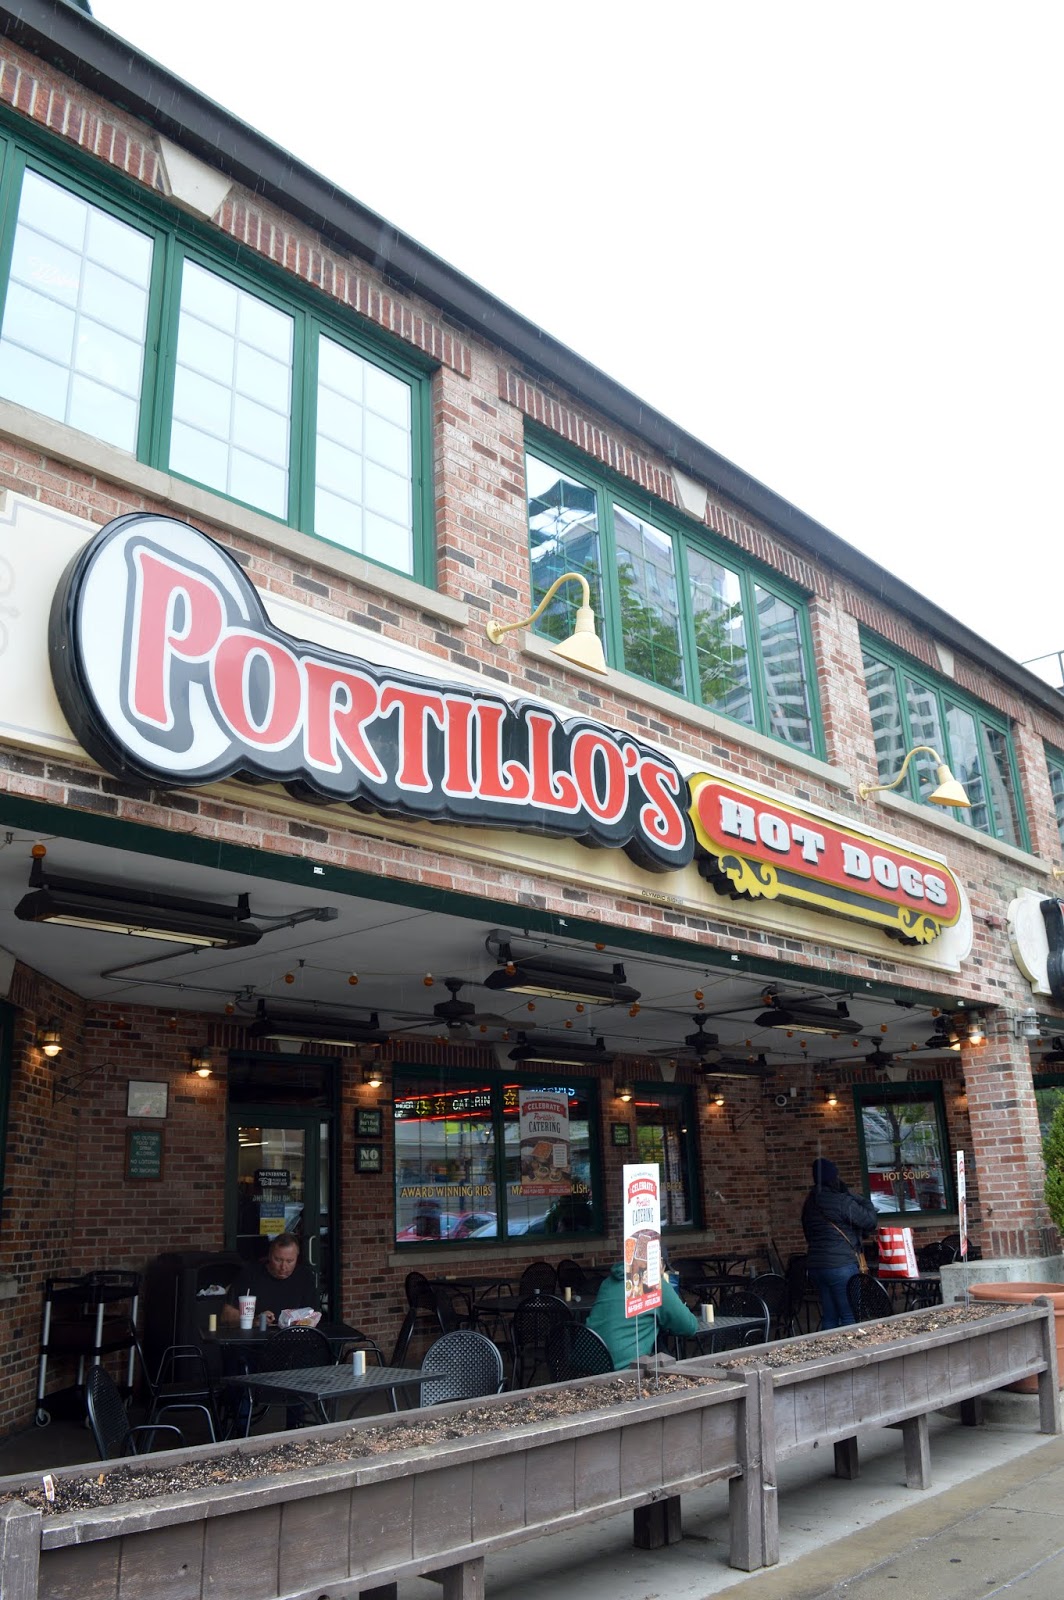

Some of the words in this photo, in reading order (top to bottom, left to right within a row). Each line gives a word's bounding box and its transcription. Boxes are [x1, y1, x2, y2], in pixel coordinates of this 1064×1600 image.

[718, 795, 824, 864] HOT
[841, 842, 948, 906] DOGS
[641, 890, 666, 901] OLYMPIC
[527, 1102, 561, 1112] CELEBRATE
[528, 1121, 561, 1134] CATERING
[361, 1149, 378, 1160] NO
[883, 1172, 900, 1181] HOT
[903, 1171, 931, 1180] SOUPS
[401, 1186, 434, 1198] AWARD
[436, 1185, 473, 1197] WINNING
[475, 1185, 493, 1197] RIBS
[631, 1181, 654, 1194] CELEBRATE
